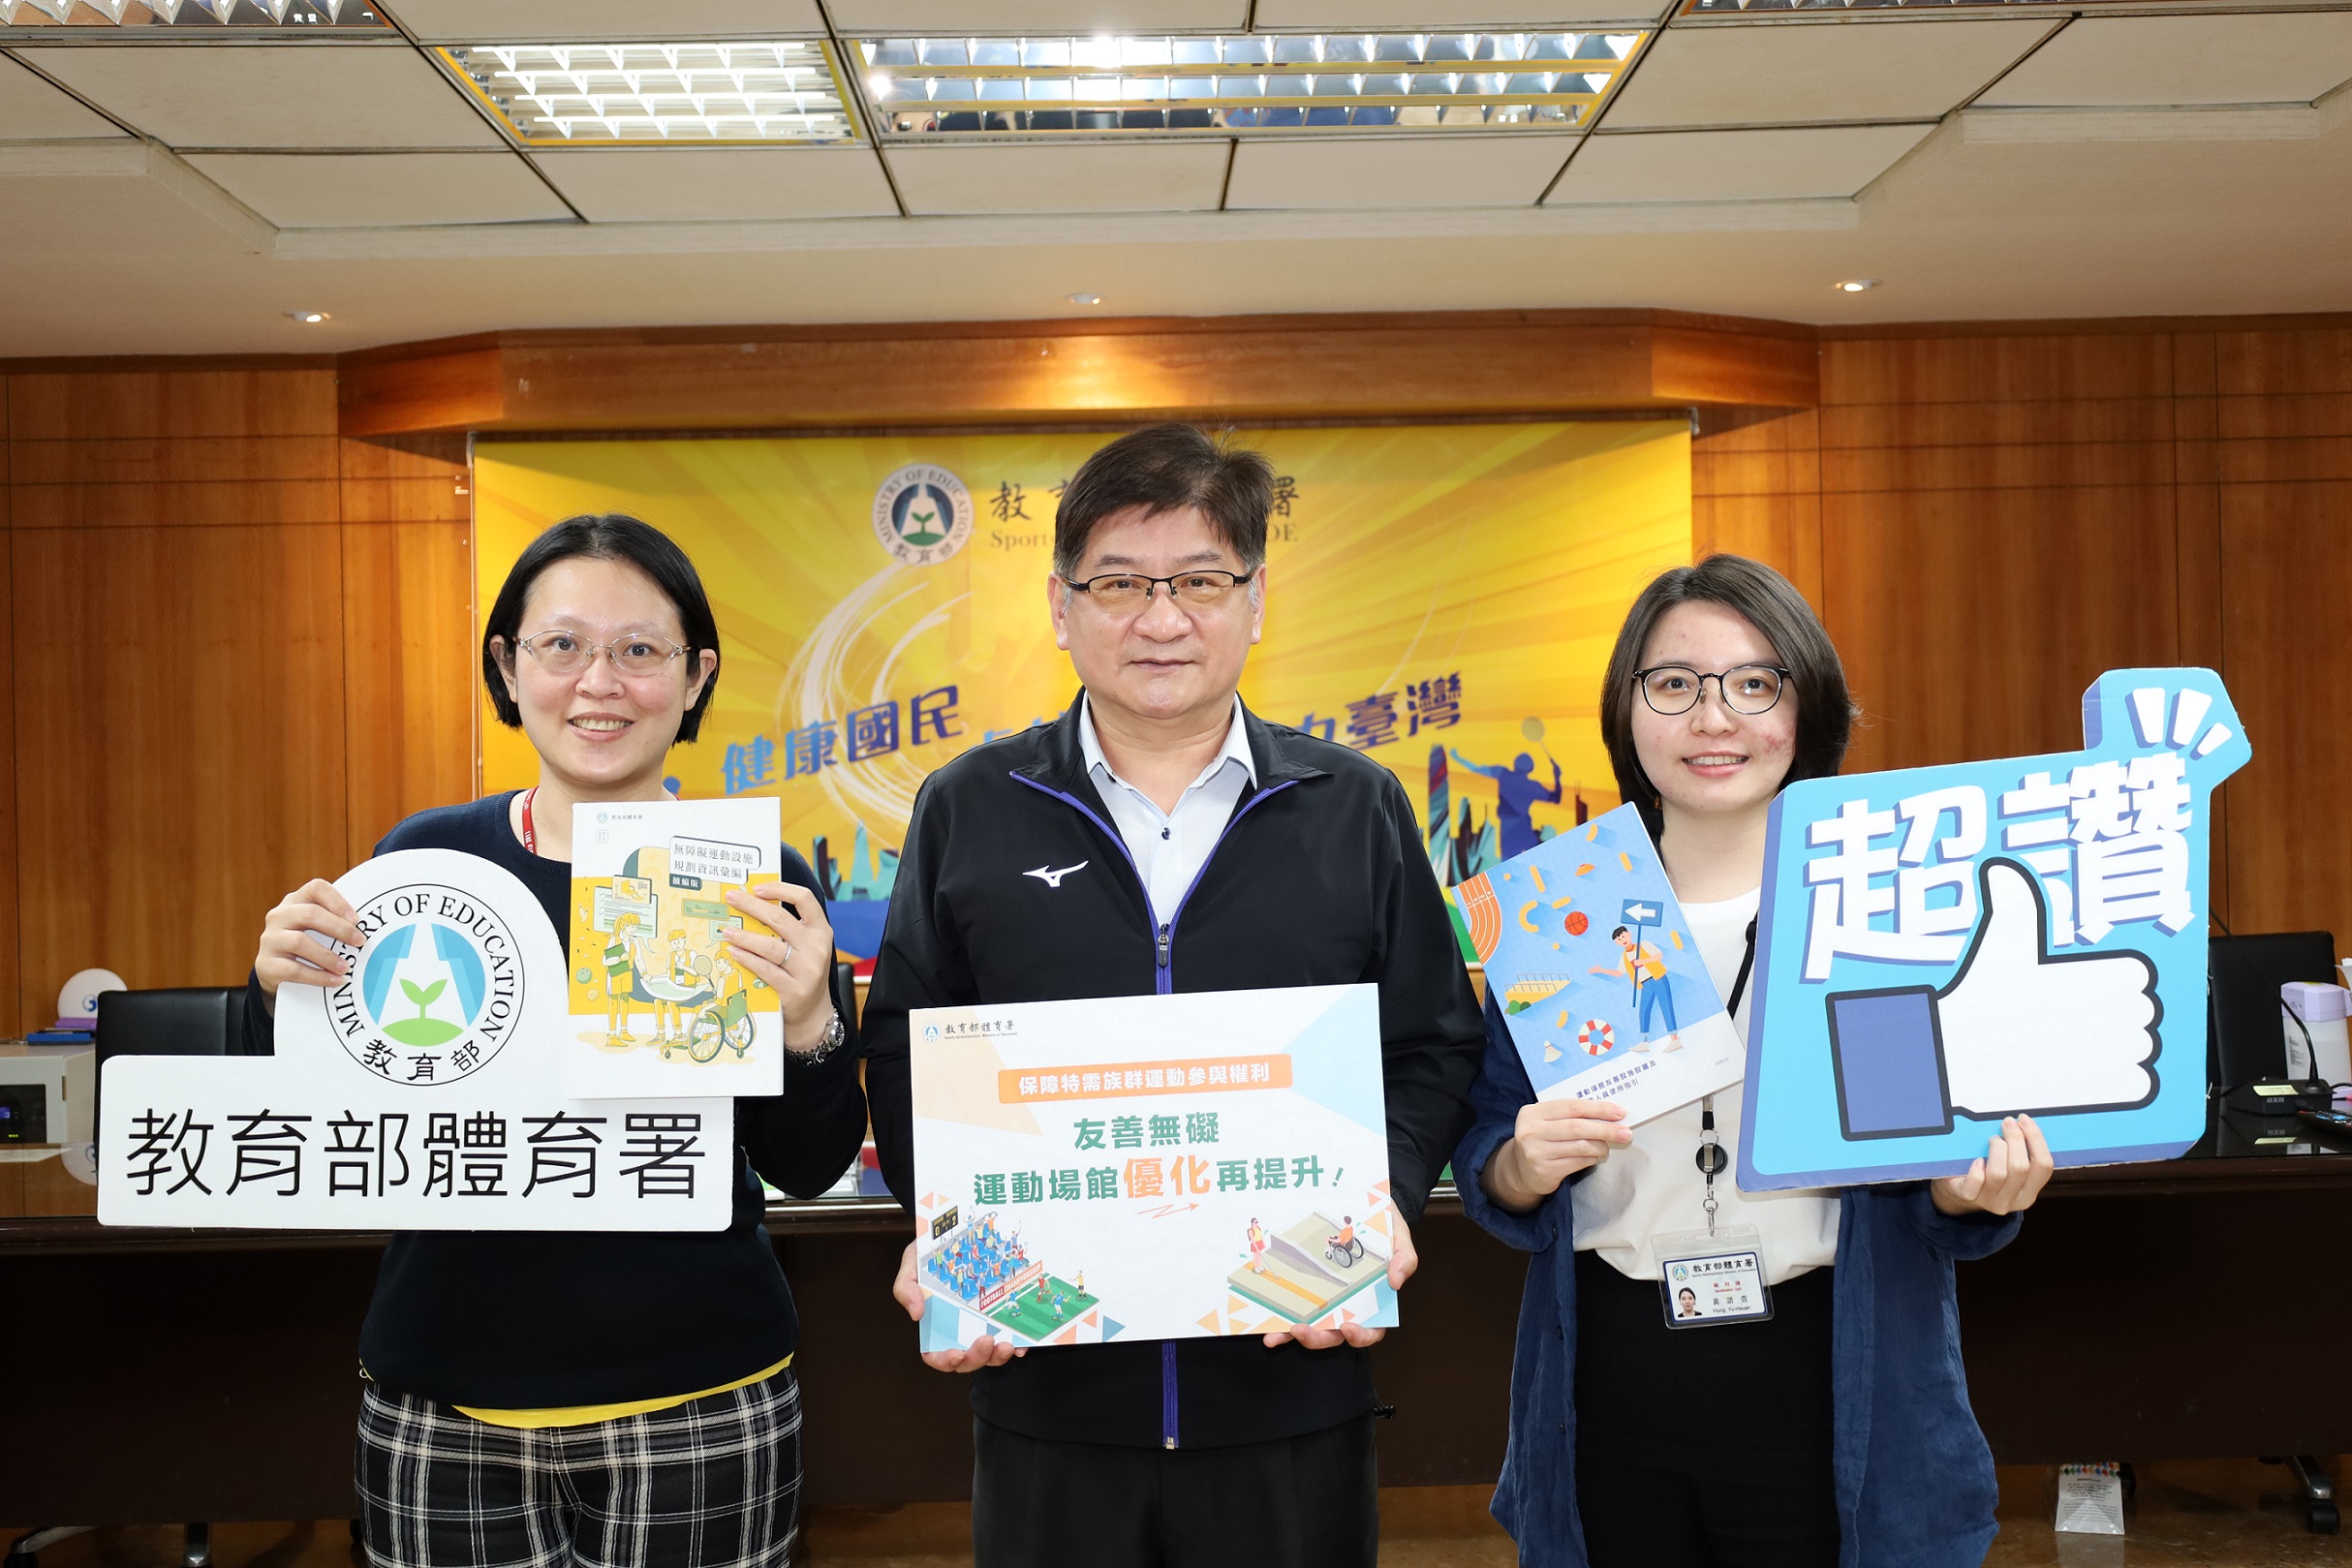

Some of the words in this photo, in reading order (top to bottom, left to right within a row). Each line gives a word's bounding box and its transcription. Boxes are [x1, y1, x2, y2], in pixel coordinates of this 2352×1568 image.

[906, 469, 925, 481] OF
[928, 470, 969, 544] EDUCATION
[721, 685, 964, 796] 健康國民
[673, 843, 754, 865] 無障礙運動設施
[1801, 752, 2196, 984] 超讚
[394, 893, 430, 916] OF
[438, 895, 514, 1042] EDUCATION
[944, 1020, 1014, 1034] 教育部體育署
[362, 1039, 480, 1081] 教育部
[1018, 1061, 1271, 1096] 保障特需族群運動參與權利
[126, 1107, 706, 1200] 教育部體育署
[1072, 1111, 1221, 1151] 友善無礙
